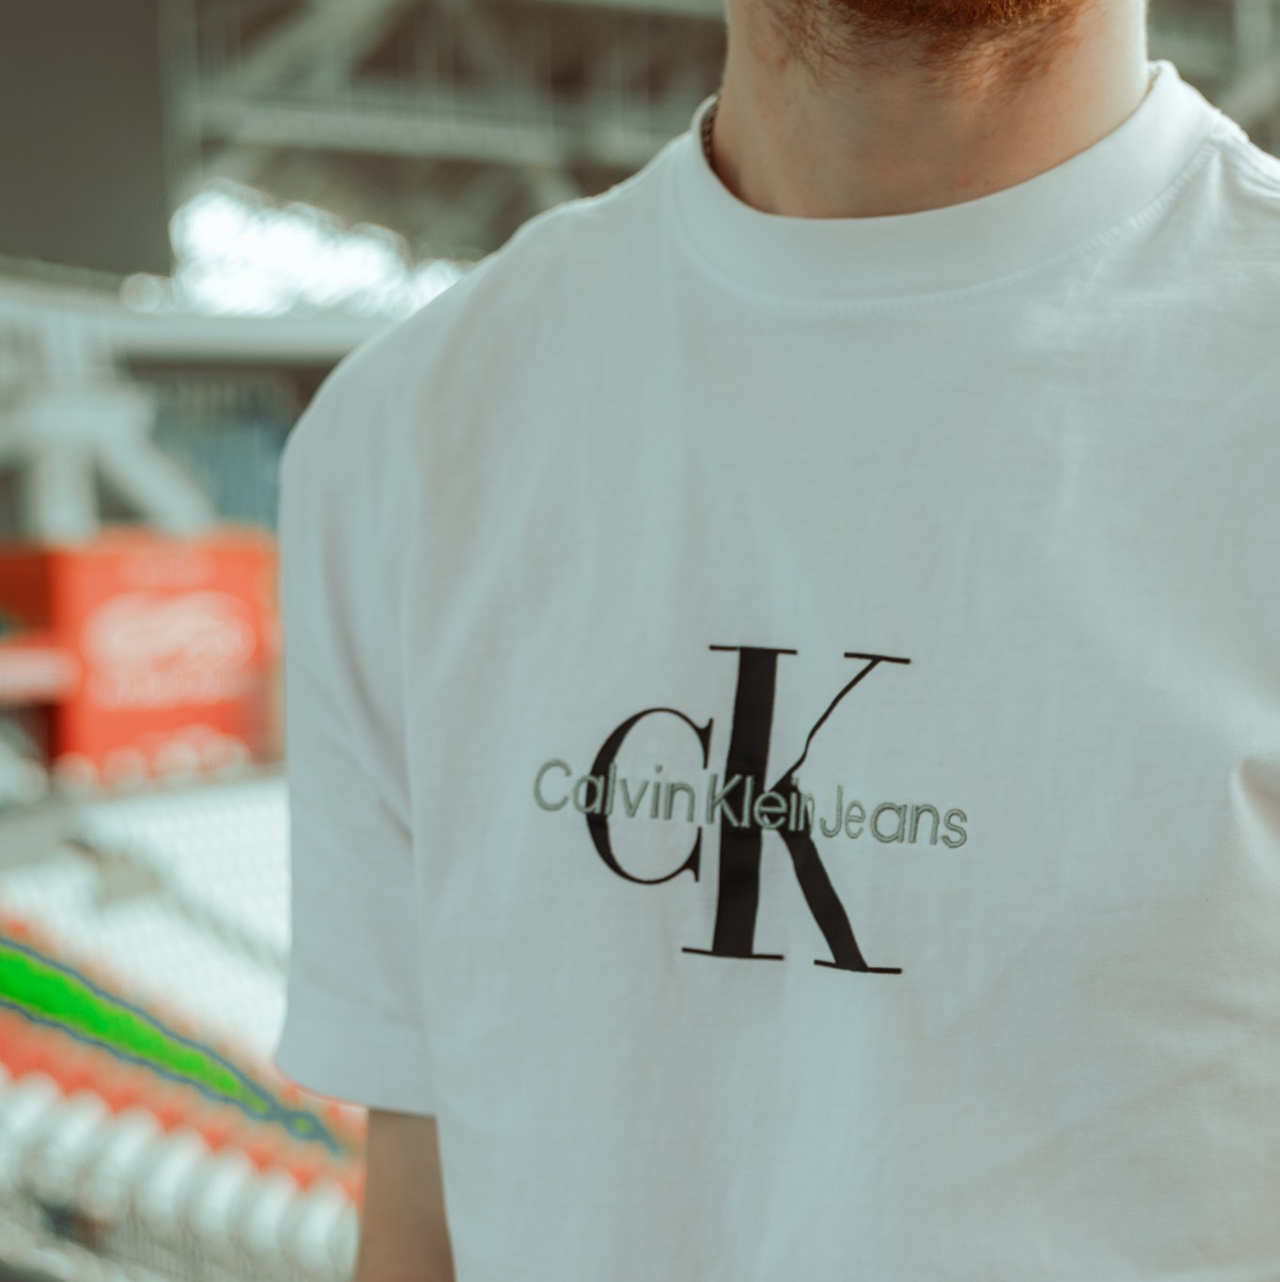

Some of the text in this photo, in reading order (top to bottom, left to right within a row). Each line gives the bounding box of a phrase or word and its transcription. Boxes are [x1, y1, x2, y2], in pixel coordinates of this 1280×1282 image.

[533, 758, 969, 849] Calvin Klein Jeans
[585, 645, 911, 974] CK
